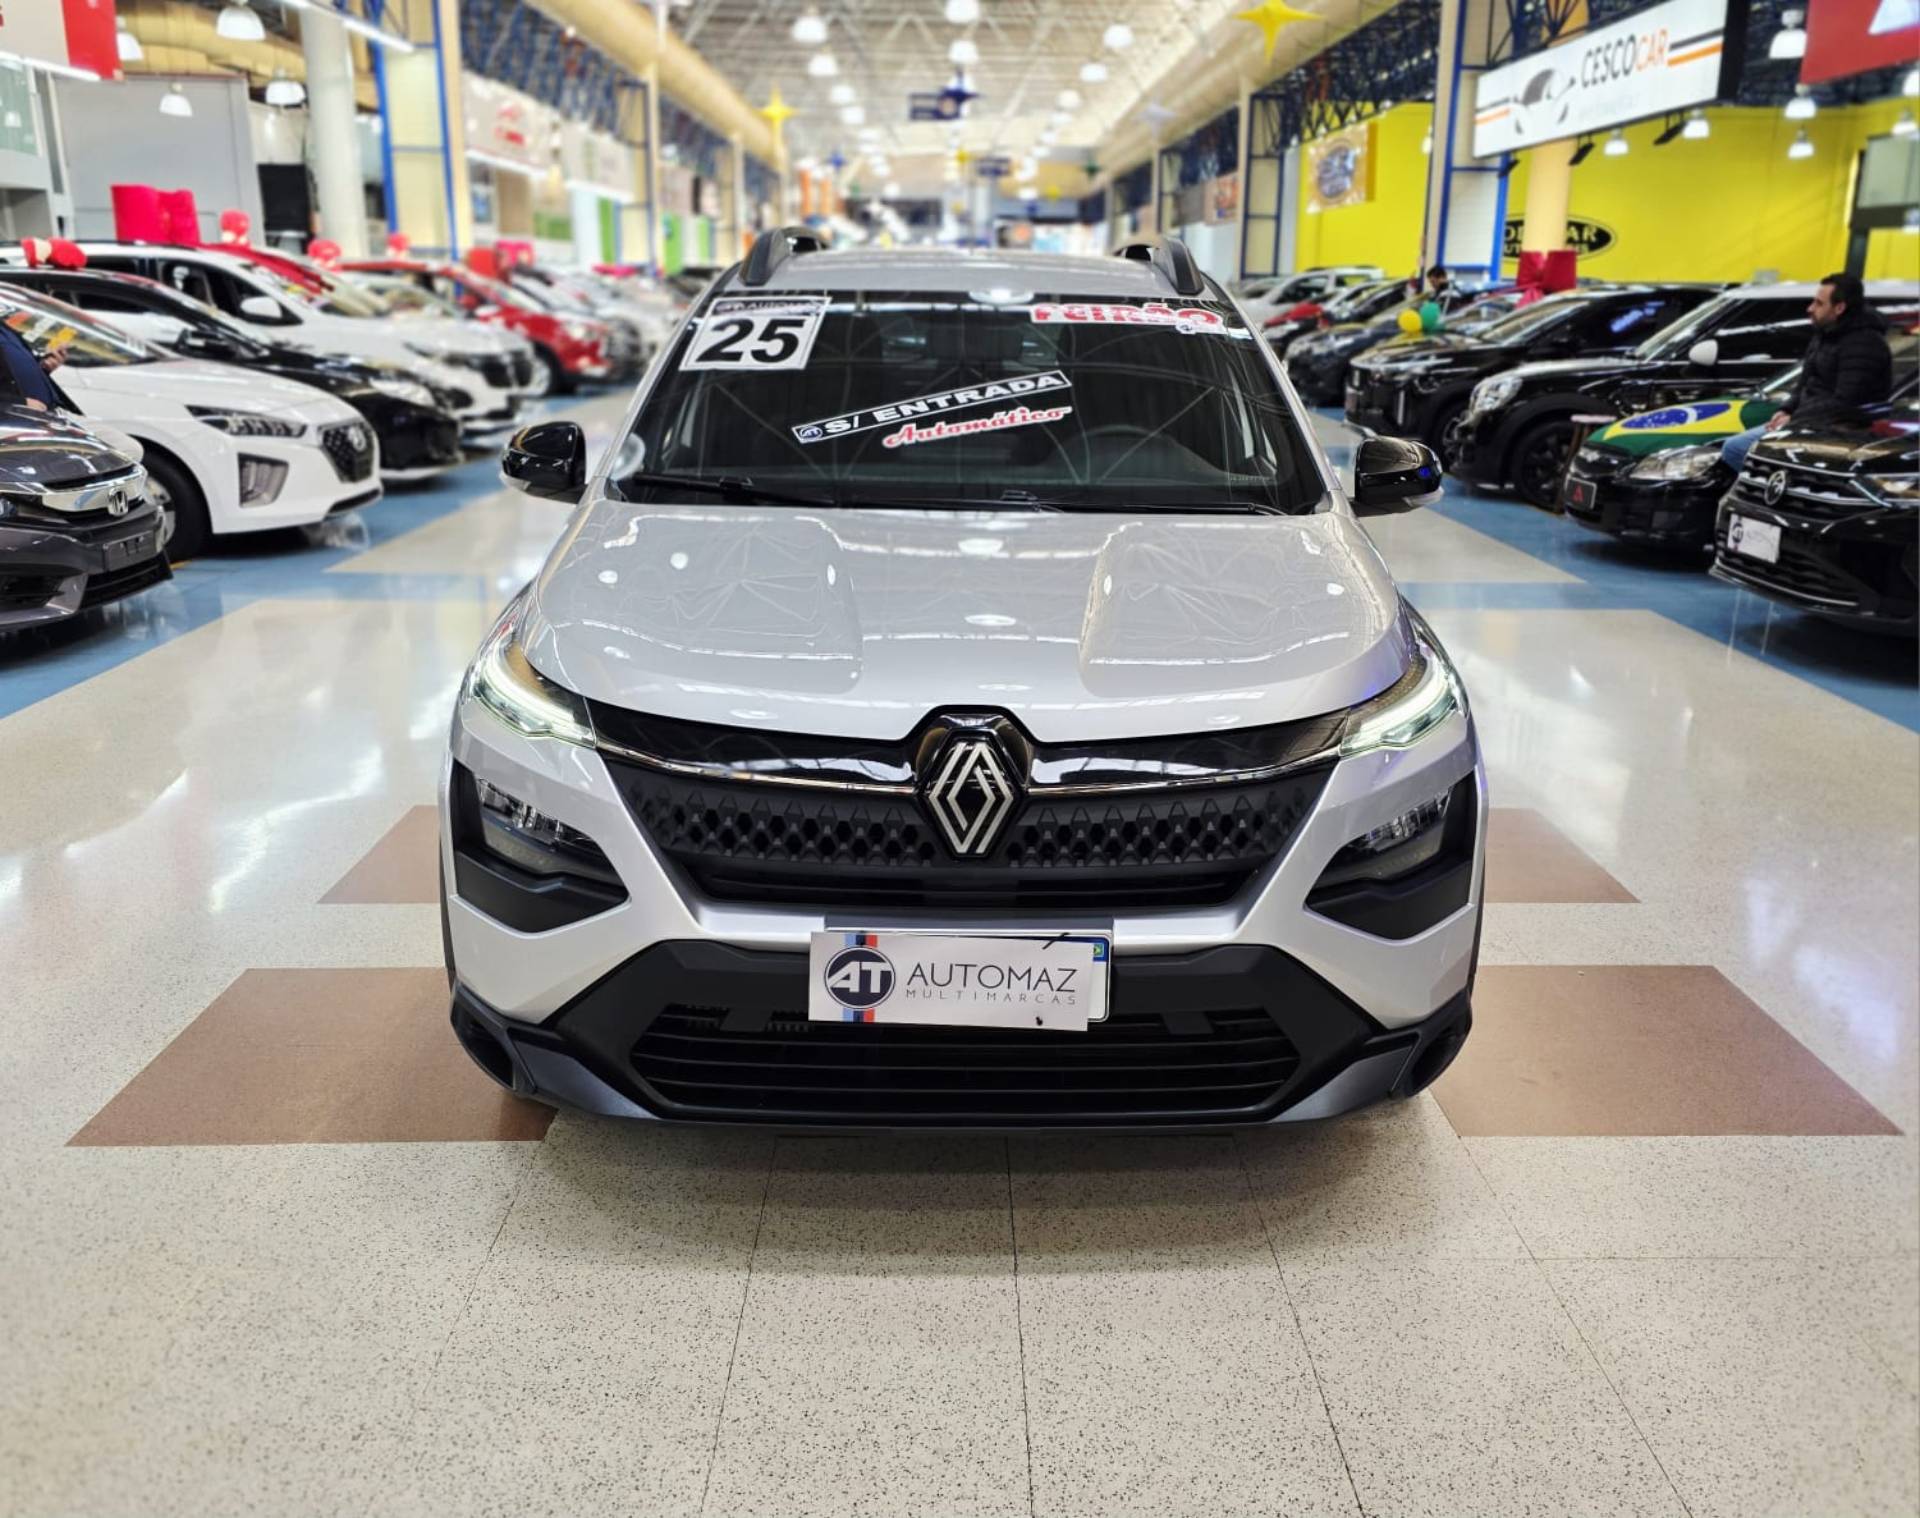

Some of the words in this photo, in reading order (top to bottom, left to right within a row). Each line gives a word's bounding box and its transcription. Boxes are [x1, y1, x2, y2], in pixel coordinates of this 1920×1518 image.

[1581, 28, 1668, 88] CESCOCAR
[694, 318, 807, 363] 25
[825, 415, 859, 433] S/
[873, 375, 1064, 422] ENTRADA
[883, 407, 1072, 448] Automático
[906, 962, 1077, 993] AUTOMAZ
[906, 989, 1076, 1006] MULTIMARCAS
